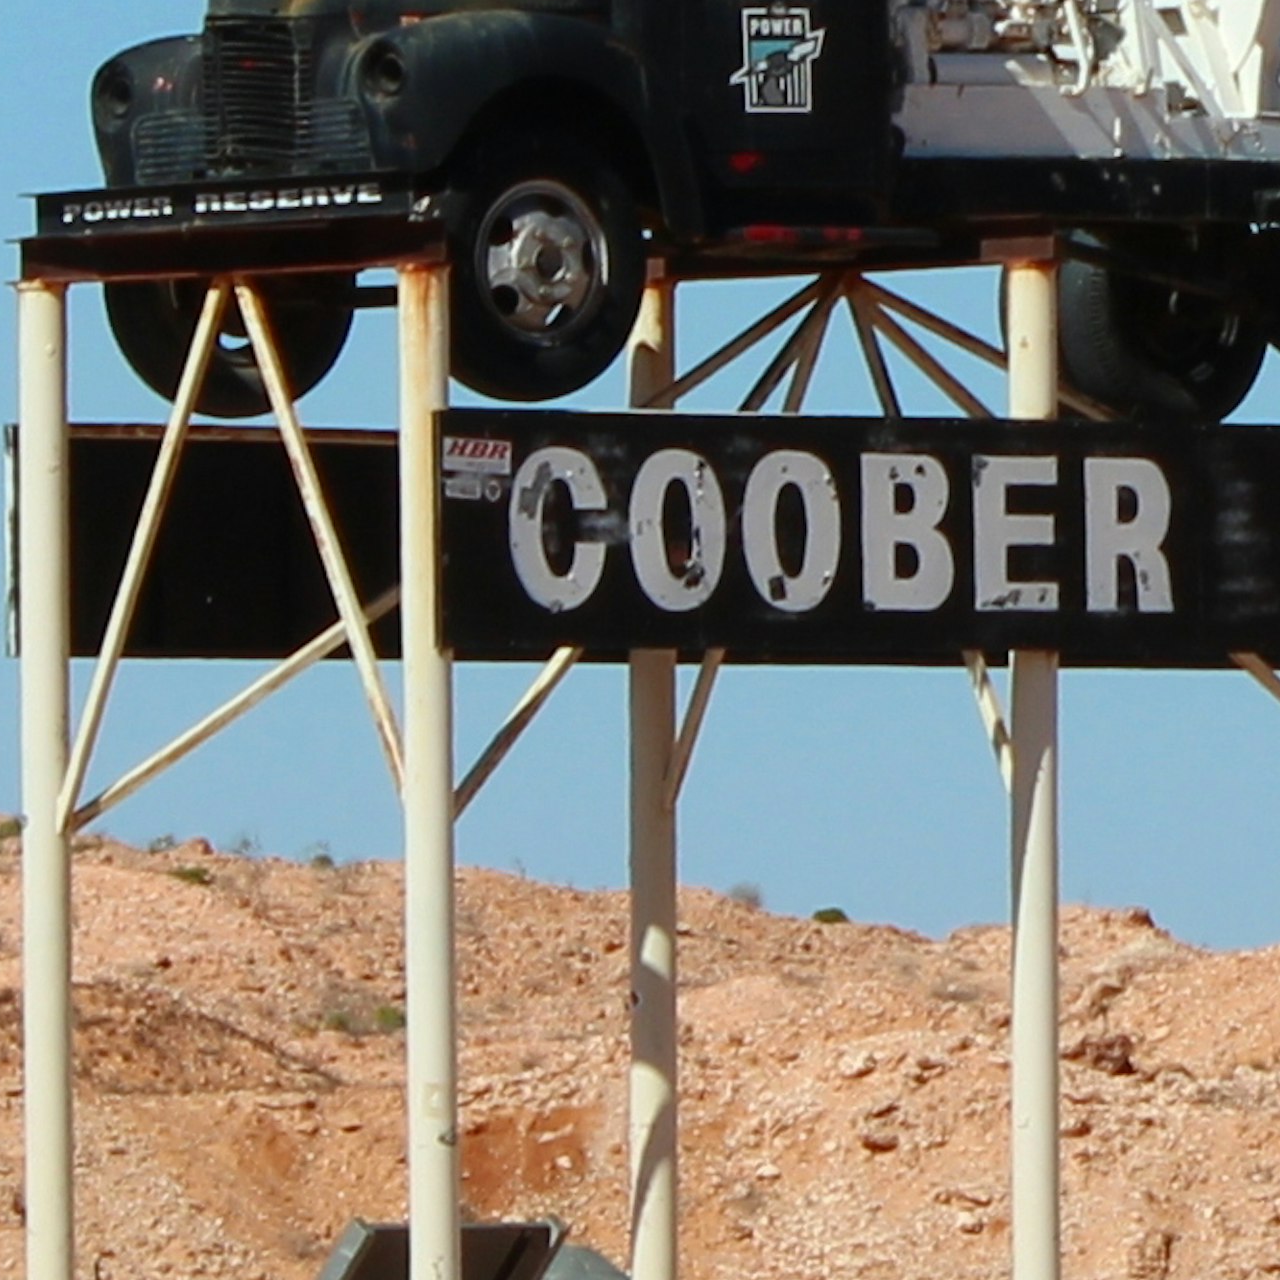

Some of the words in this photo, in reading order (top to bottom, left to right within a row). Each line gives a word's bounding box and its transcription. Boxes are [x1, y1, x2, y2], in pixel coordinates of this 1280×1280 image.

[749, 18, 802, 36] POWER
[62, 195, 174, 223] POWER
[194, 182, 383, 214] RESERVE
[508, 446, 1175, 613] COOBER
